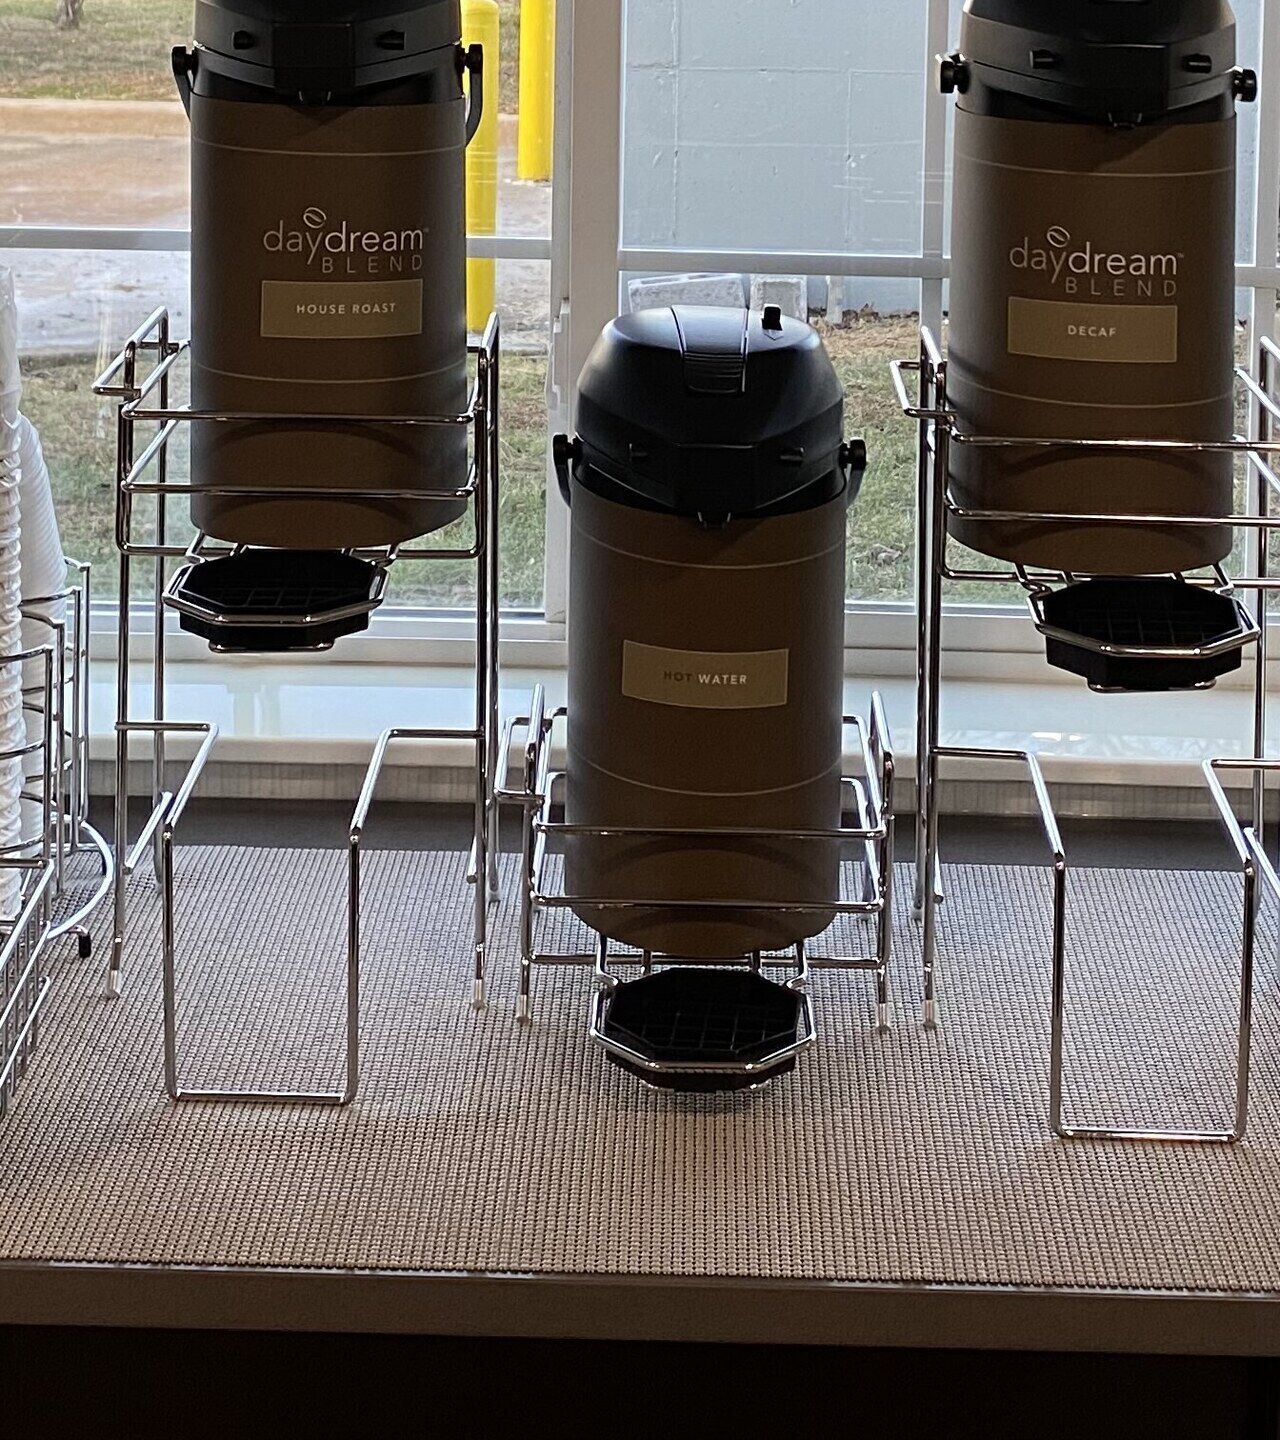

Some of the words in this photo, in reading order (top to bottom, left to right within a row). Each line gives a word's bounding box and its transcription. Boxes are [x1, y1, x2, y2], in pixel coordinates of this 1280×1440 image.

[322, 255, 423, 273] BLEND
[1065, 277, 1177, 297] BLEND
[296, 303, 346, 315] HOUSE
[352, 302, 396, 314] ROAST
[1067, 324, 1117, 338] DECAF
[663, 670, 693, 683] HOT
[697, 673, 748, 685] WATER
